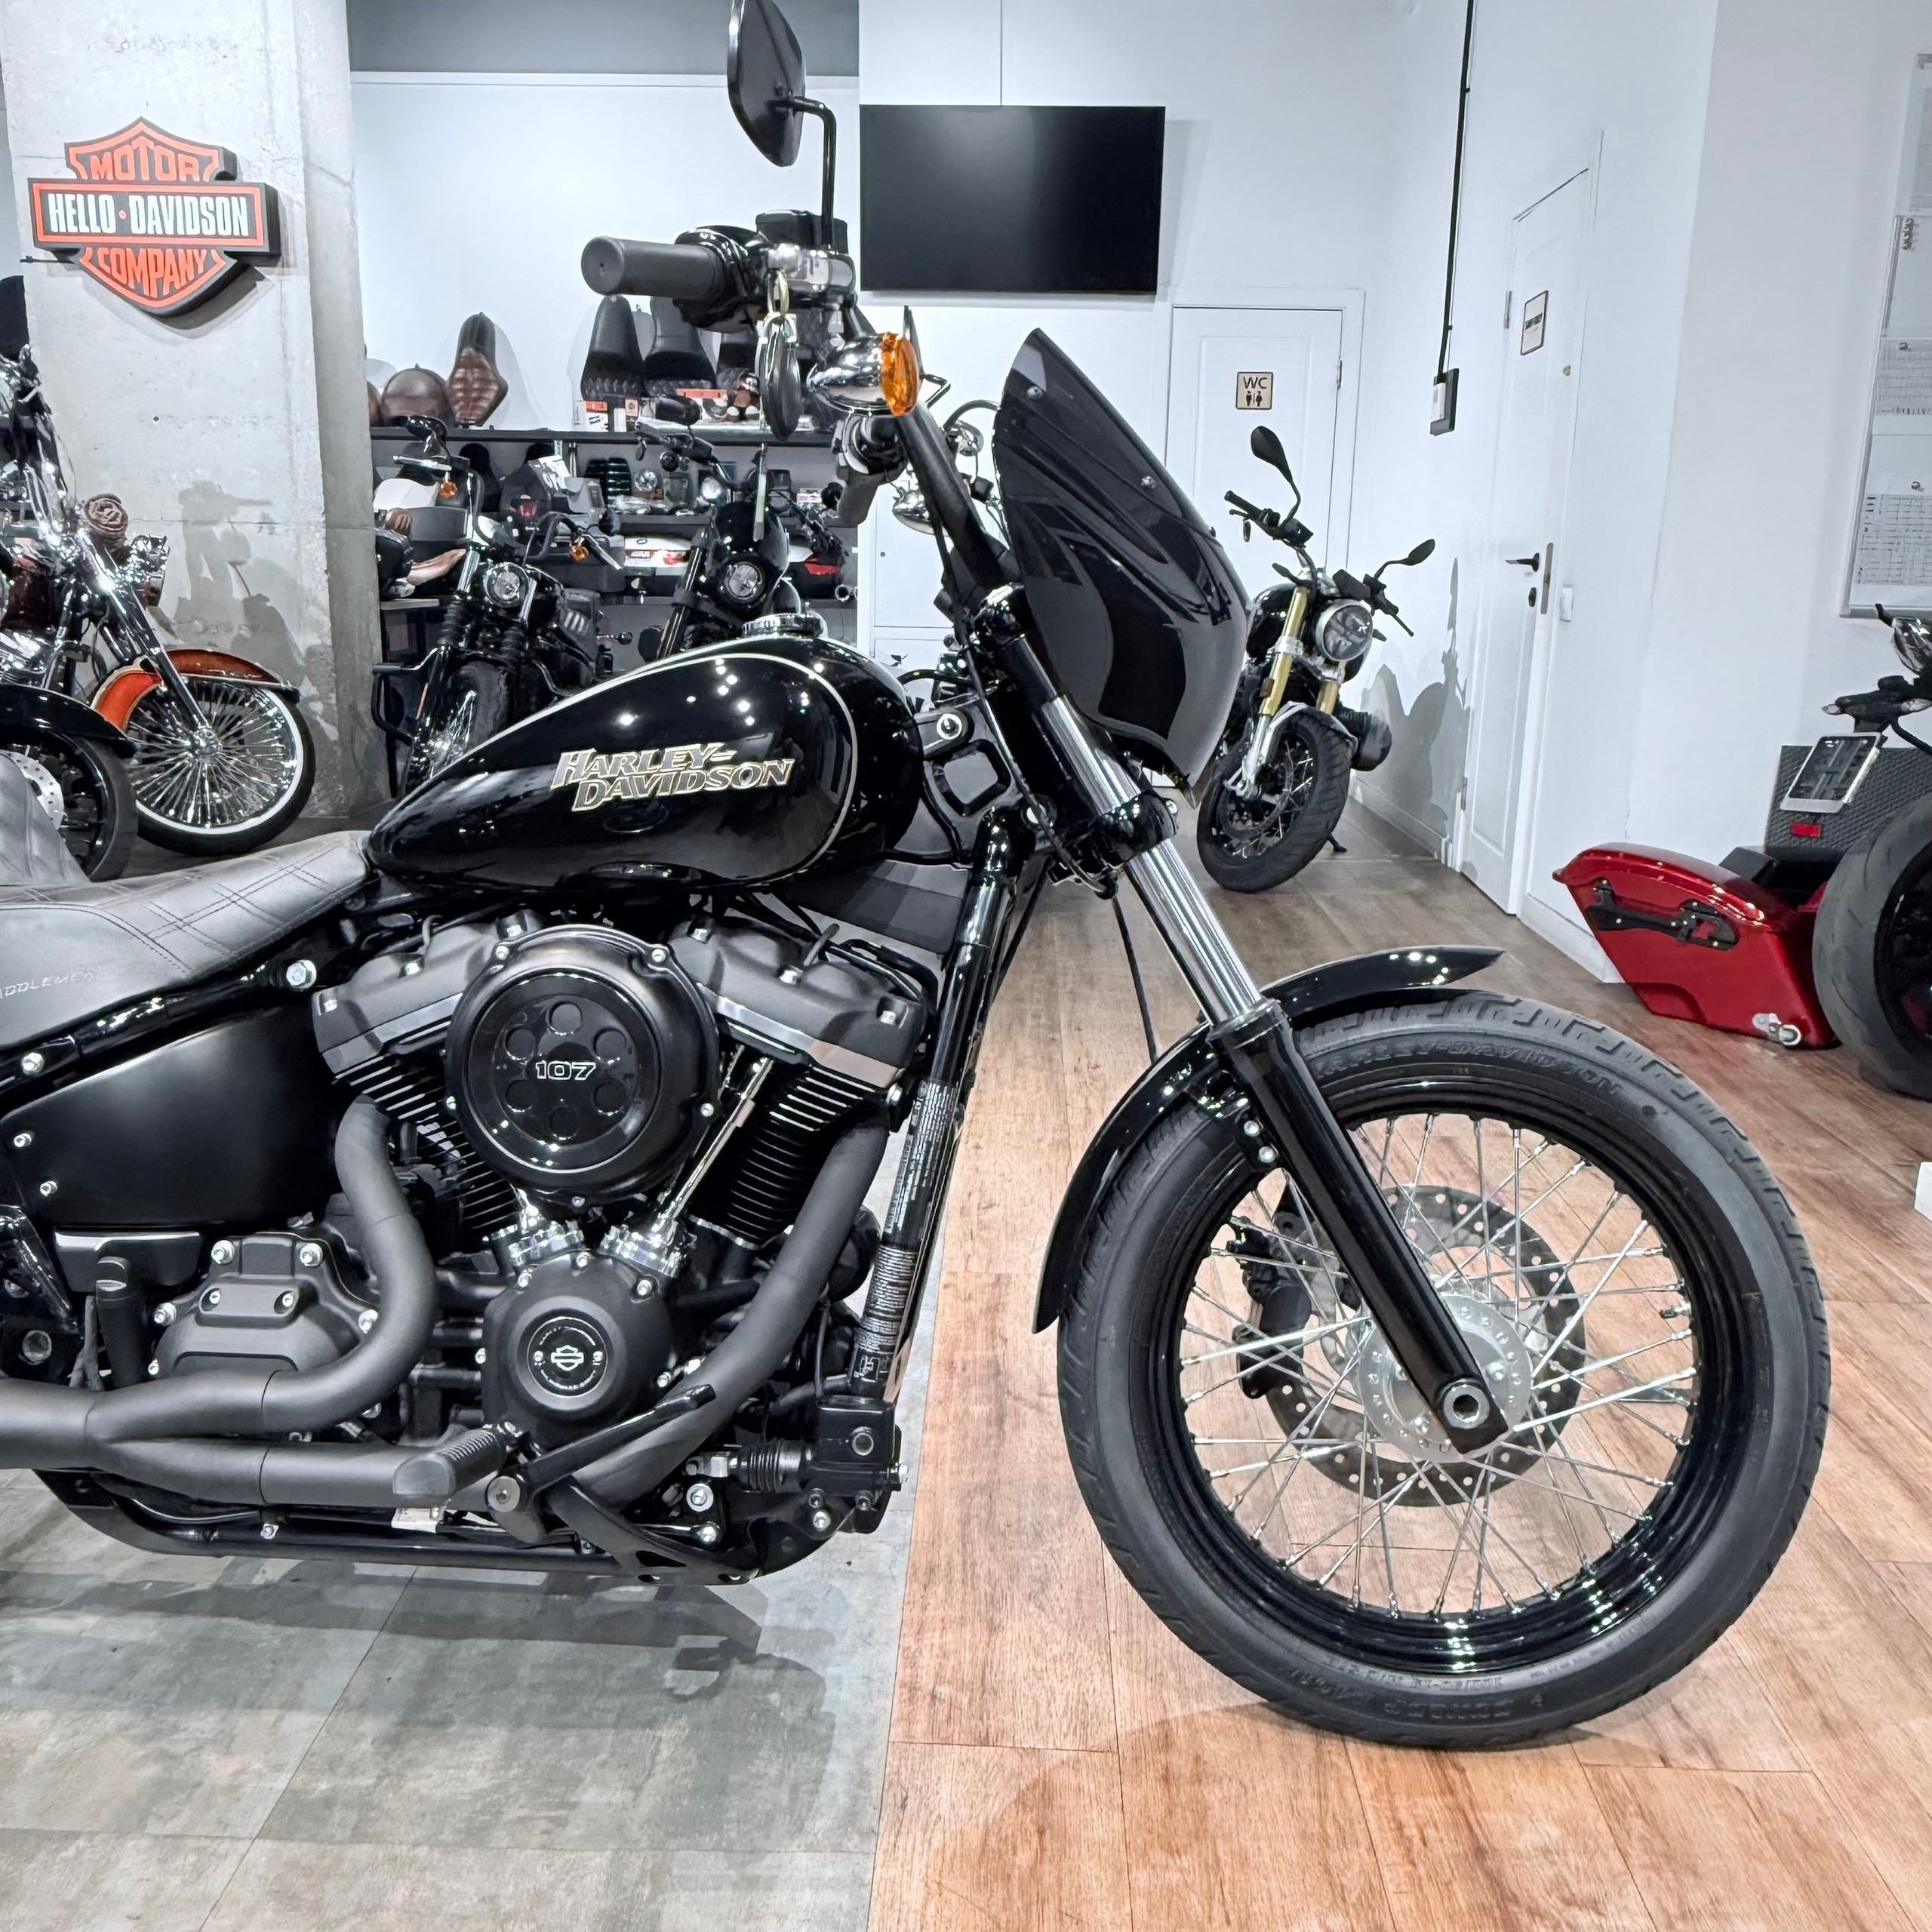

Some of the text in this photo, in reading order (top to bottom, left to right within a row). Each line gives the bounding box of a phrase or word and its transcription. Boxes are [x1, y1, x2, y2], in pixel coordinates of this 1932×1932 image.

[89, 137, 199, 182] MOTOR
[48, 193, 249, 236] HELLO DAVIDSON
[97, 247, 207, 299] COMPANY
[1242, 376, 1268, 389] WC
[571, 758, 795, 812] DAVIDSON
[535, 1060, 596, 1081] 107
